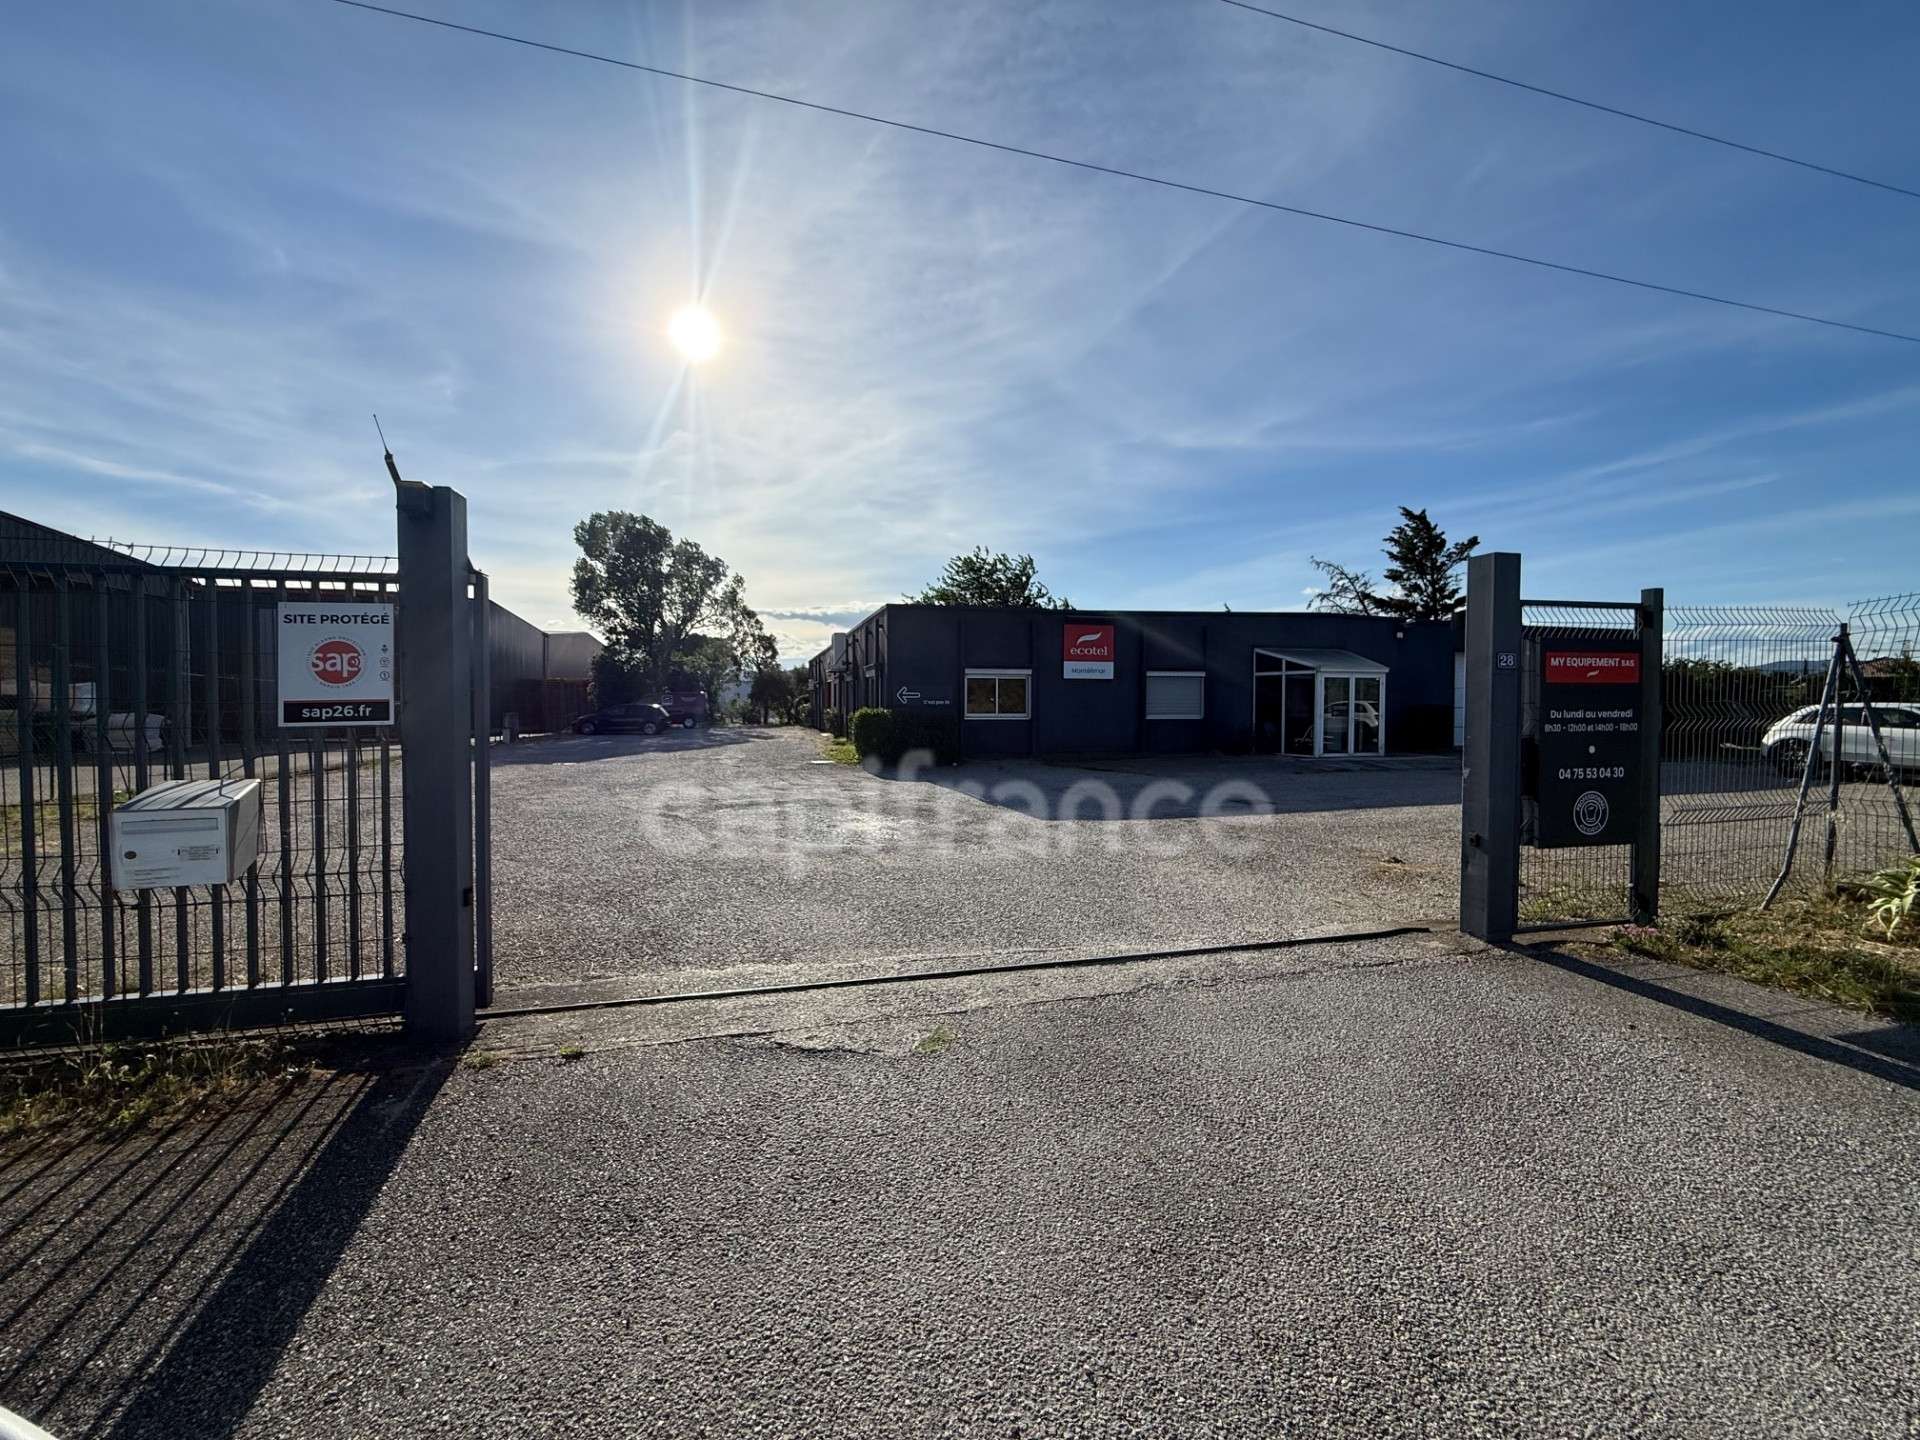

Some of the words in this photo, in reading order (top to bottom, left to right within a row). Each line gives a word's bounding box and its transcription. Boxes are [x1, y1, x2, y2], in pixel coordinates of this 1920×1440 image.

[283, 614, 316, 625] SITE
[320, 612, 390, 625] PROTÉGÉ
[1070, 646, 1108, 656] ecotel
[311, 652, 361, 677] sap
[1499, 655, 1514, 666] 28
[1550, 657, 1565, 667] MY
[1566, 657, 1620, 667] EQUIPEMENT
[302, 705, 372, 720] sap26.fr
[1550, 710, 1562, 719] Du
[1563, 709, 1584, 719] lundi
[1585, 710, 1596, 719] au
[1597, 708, 1633, 718] vendredi
[1587, 724, 1594, 732] et
[1558, 768, 1571, 780] 04
[1572, 767, 1584, 780] 75
[1586, 767, 1598, 779] 53
[1599, 767, 1611, 778] 04
[1613, 766, 1625, 778] 30
